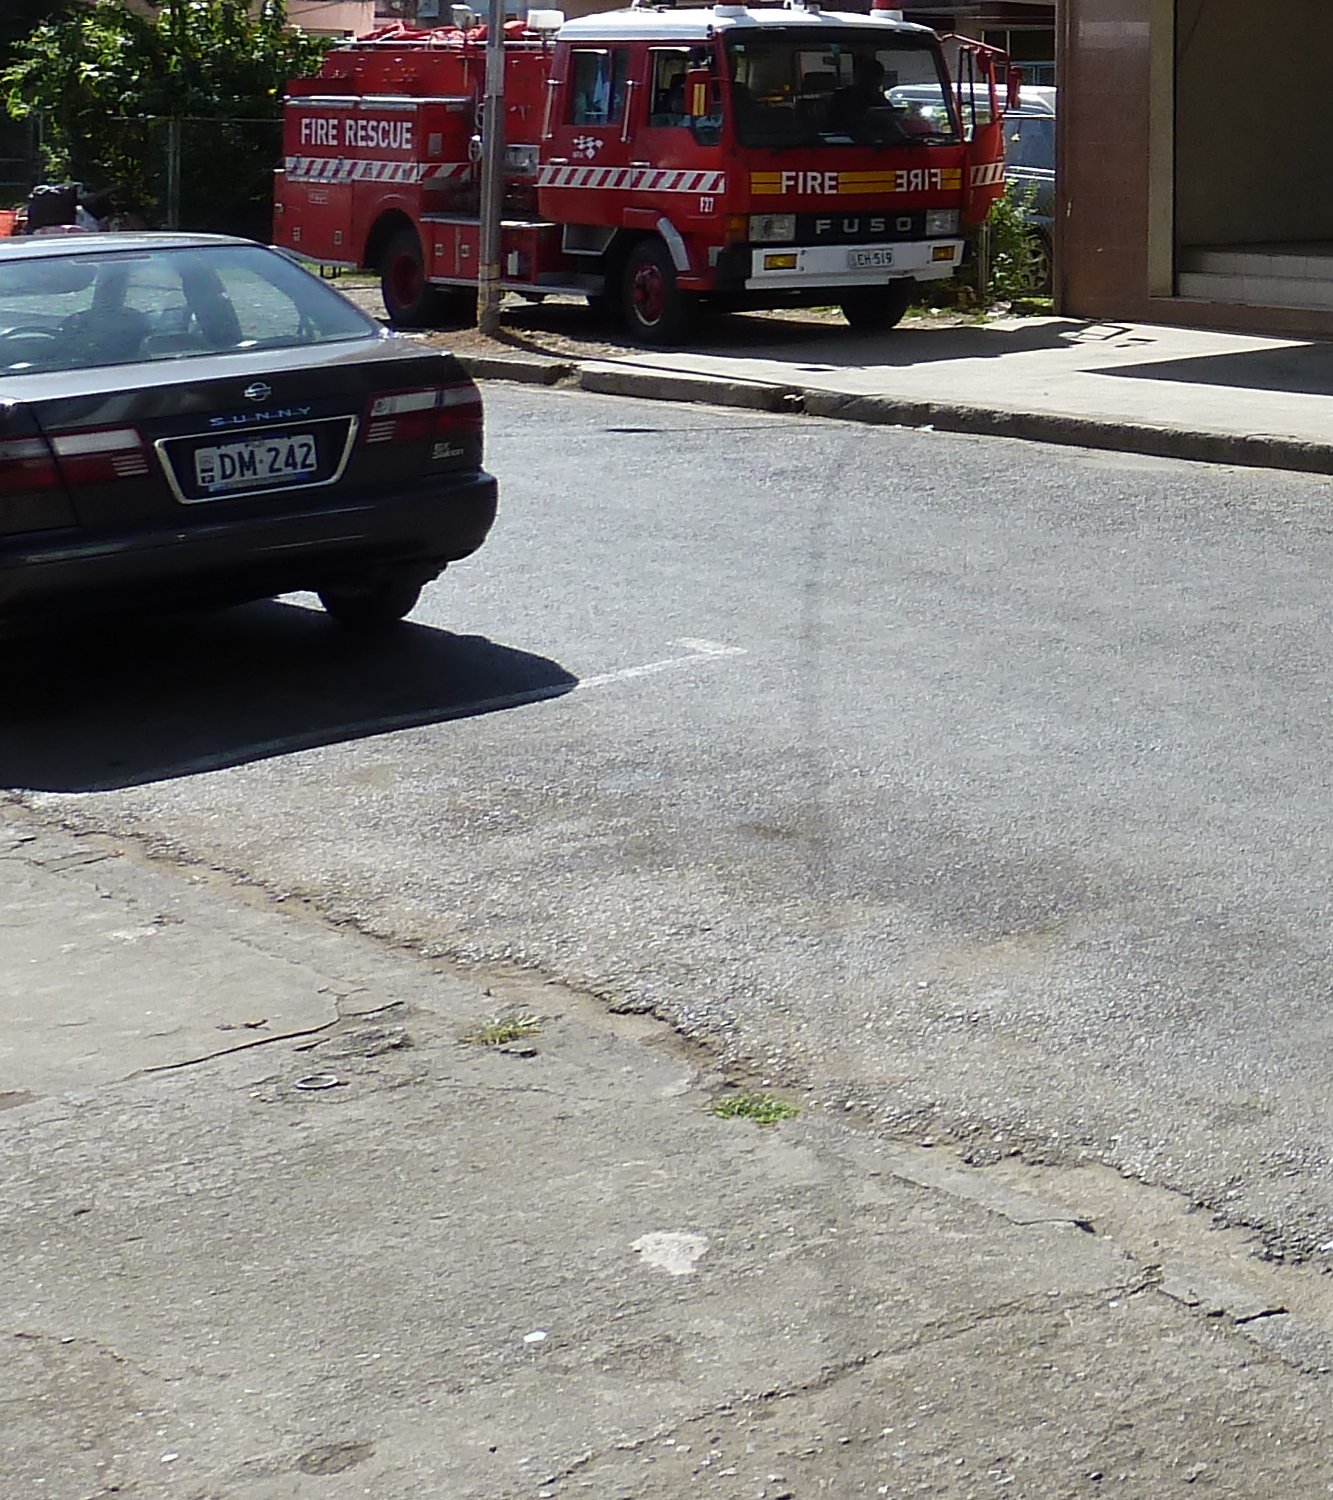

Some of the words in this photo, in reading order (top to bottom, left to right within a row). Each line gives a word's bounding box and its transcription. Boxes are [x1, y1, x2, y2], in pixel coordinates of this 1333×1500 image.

[301, 118, 339, 146] FIRE
[344, 120, 413, 150] RESCUE
[780, 171, 839, 195] FIRE
[815, 216, 913, 235] FUSO
[208, 406, 312, 427] SUNNY
